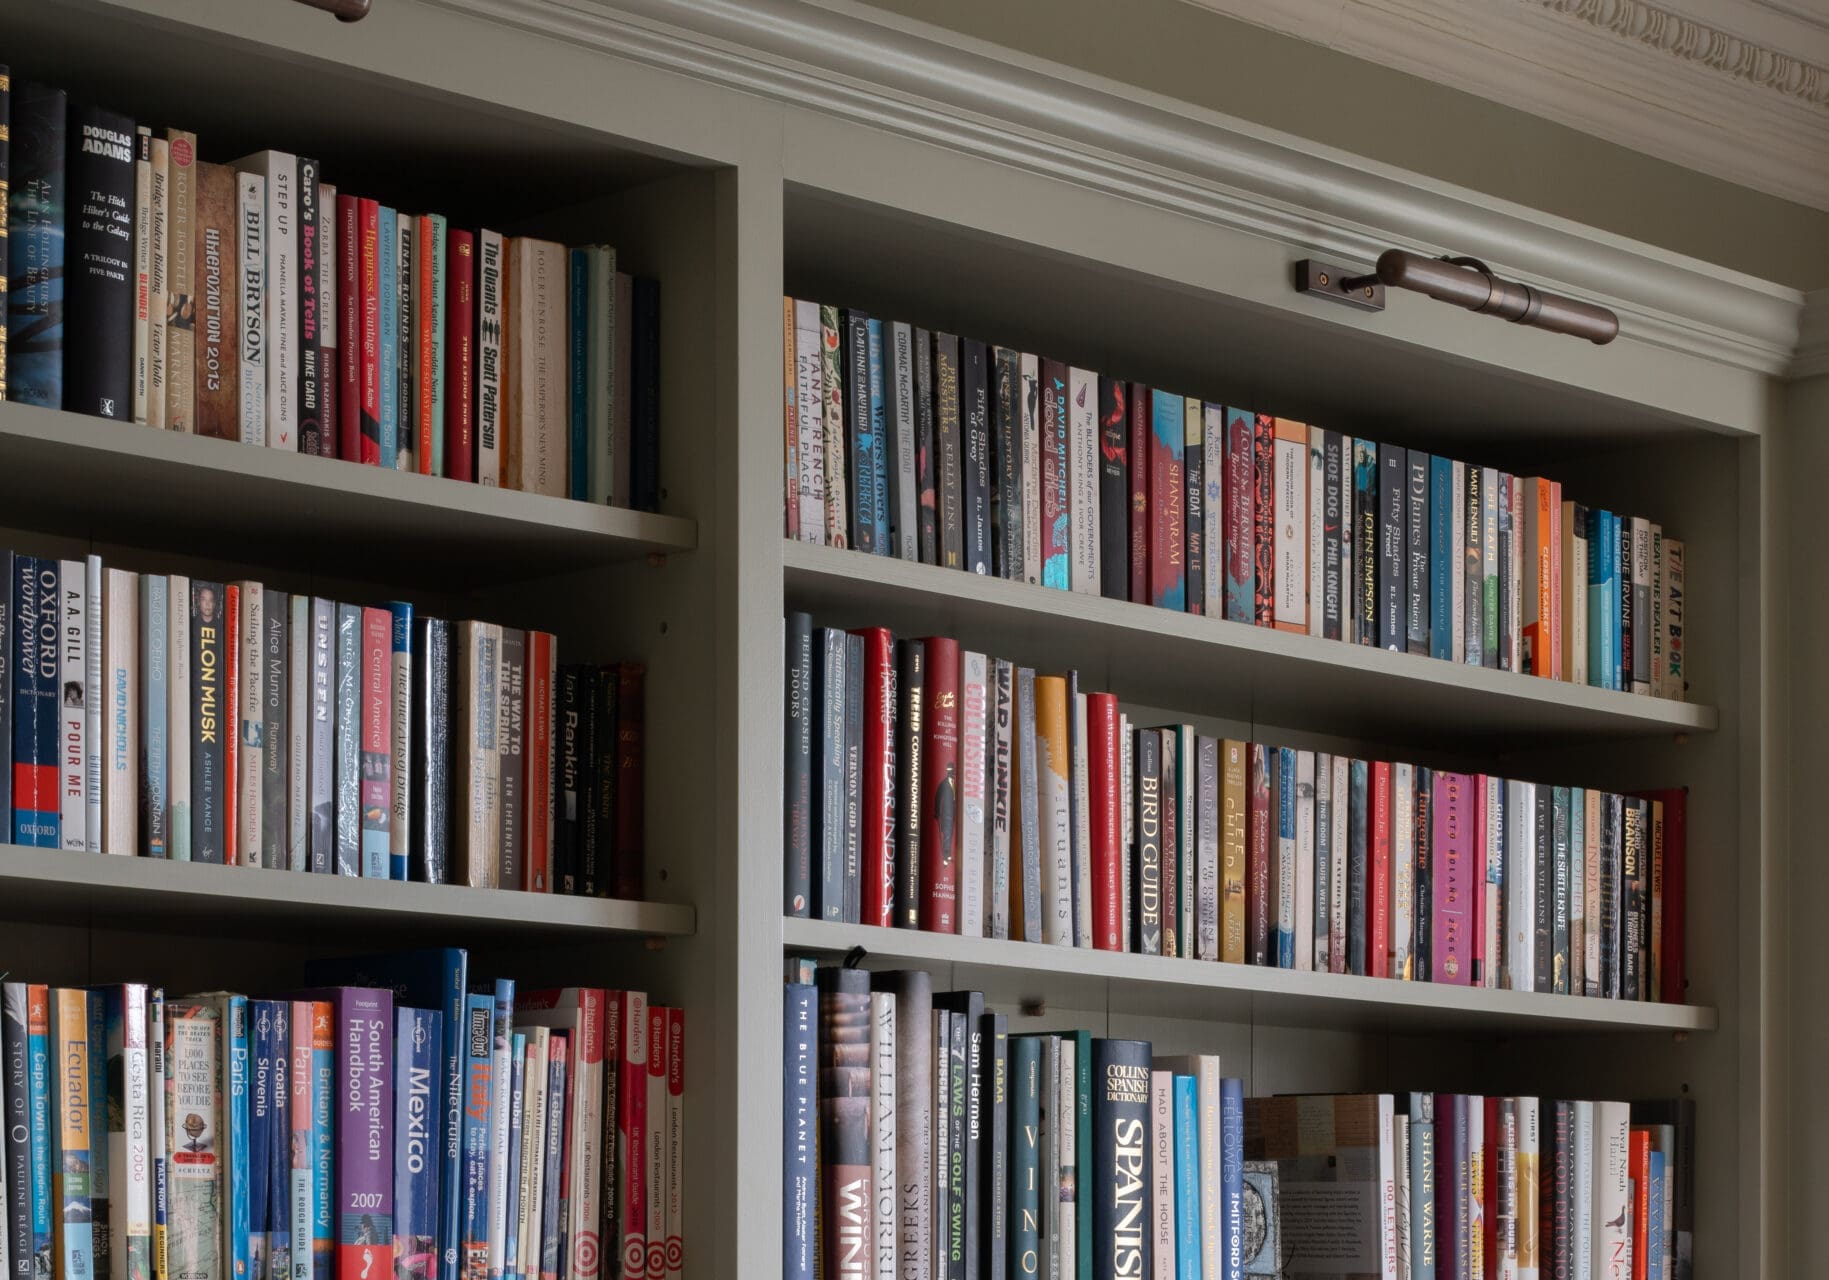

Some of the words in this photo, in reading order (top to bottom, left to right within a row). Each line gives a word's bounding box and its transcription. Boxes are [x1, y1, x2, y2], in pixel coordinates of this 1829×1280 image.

[82, 138, 131, 163] ADAMS
[83, 125, 131, 147] DOUGLAS
[277, 174, 289, 210] STEP
[302, 164, 316, 221] Caro's
[245, 210, 260, 261] BILL
[277, 214, 289, 236] UP
[303, 224, 316, 270] Book
[364, 229, 376, 292] Happiness
[484, 242, 499, 264] The
[303, 274, 317, 295] of
[483, 266, 498, 315] Quants
[246, 268, 262, 363] BRYSON
[303, 298, 317, 339] Tells
[364, 295, 377, 357] Advantage
[206, 346, 220, 391] 2013
[304, 350, 315, 378] MIKE
[483, 347, 497, 381] Scott
[898, 331, 908, 371] CORMAC
[304, 381, 316, 409] CARO
[800, 356, 808, 435] FAITHFUL
[811, 351, 821, 406] TANA
[899, 374, 909, 425] McCARTHY
[483, 385, 497, 449] Patterson
[1057, 395, 1066, 438] DAVID
[801, 442, 809, 495] PLACE
[813, 417, 823, 500] FRENCH
[1057, 443, 1066, 511] MITCHELL
[1328, 444, 1338, 483] SHOE
[1169, 464, 1180, 565] SHANTARAM
[1328, 485, 1338, 518] DOG
[1327, 538, 1337, 568] PHIL
[1364, 511, 1374, 553] JOHN
[1653, 532, 1661, 570] BEAT
[67, 591, 80, 620] A.A.
[1327, 570, 1338, 621] KNIGHT
[1365, 556, 1374, 622] SIMPSON
[1653, 571, 1661, 599] THE
[18, 567, 39, 677] wordpower
[40, 570, 57, 679] OXFORD
[67, 626, 80, 664] GILL
[270, 619, 282, 654] Alice
[201, 627, 215, 682] ELON
[317, 615, 328, 722] UNSEEN
[373, 649, 383, 693] Central
[116, 668, 127, 707] DAVID
[270, 658, 281, 707] Munro
[565, 674, 575, 703] Ian
[791, 668, 800, 719] DOORS
[201, 686, 215, 744] MUSK
[372, 697, 383, 747] America
[801, 697, 809, 755] CLOSED
[68, 721, 80, 766] POUR
[116, 709, 127, 771] NICHOLLS
[269, 721, 279, 774] Runaway
[565, 710, 577, 787] Rankin
[964, 683, 985, 799] COLLUSION
[68, 774, 81, 797] ME
[204, 752, 212, 792] ASHLEE
[505, 776, 513, 798] BEN
[848, 745, 857, 797] VERNON
[204, 796, 212, 833] VANCE
[849, 802, 857, 828] GOD
[1143, 776, 1158, 837] BIRD
[1418, 791, 1430, 870] Tangerine
[504, 803, 513, 875] EHRENREICH
[848, 832, 856, 877] LITTLE
[1625, 807, 1635, 876] BRANSON
[1142, 843, 1158, 926] GUIDE
[1538, 871, 1546, 924] VILLAINS
[799, 1000, 808, 1031] THE
[12, 1041, 24, 1089] STORY
[232, 1047, 245, 1096] Paris
[294, 1046, 310, 1095] Paris
[349, 1019, 364, 1112] Handbook
[369, 1020, 384, 1074] South
[798, 1043, 808, 1086] BLUE
[952, 1047, 964, 1062] 7
[970, 1032, 981, 1069] Sam
[67, 1040, 85, 1134] Ecuador
[132, 1052, 144, 1099] Costa
[256, 1058, 268, 1117] Slovenia
[275, 1058, 286, 1108] Croatia
[317, 1067, 331, 1127] Brittany
[465, 1064, 490, 1122] Italy
[878, 1007, 893, 1153] WILLIAM
[952, 1065, 964, 1116] LAWS
[14, 1098, 24, 1117] OF
[132, 1105, 144, 1139] Rica
[369, 1076, 383, 1161] American
[408, 1067, 430, 1173] Mexico
[970, 1074, 982, 1140] Herman
[1158, 1088, 1166, 1115] MAD
[11, 1125, 29, 1143] O
[319, 1134, 329, 1149] &
[798, 1098, 807, 1163] PLANET
[1159, 1123, 1167, 1169] ABOUT
[16, 1155, 25, 1208] PAULINE
[133, 1145, 144, 1182] 2006
[952, 1152, 963, 1198] GOLF
[1159, 1174, 1167, 1196] THE
[1423, 1131, 1432, 1193] SHANE
[318, 1149, 330, 1227] Normandy
[351, 1192, 383, 1208] 2007
[951, 1203, 963, 1262] SWING
[1159, 1203, 1169, 1245] HOUSE
[1230, 1201, 1240, 1267] MITFORD
[1423, 1201, 1433, 1266] WARNE
